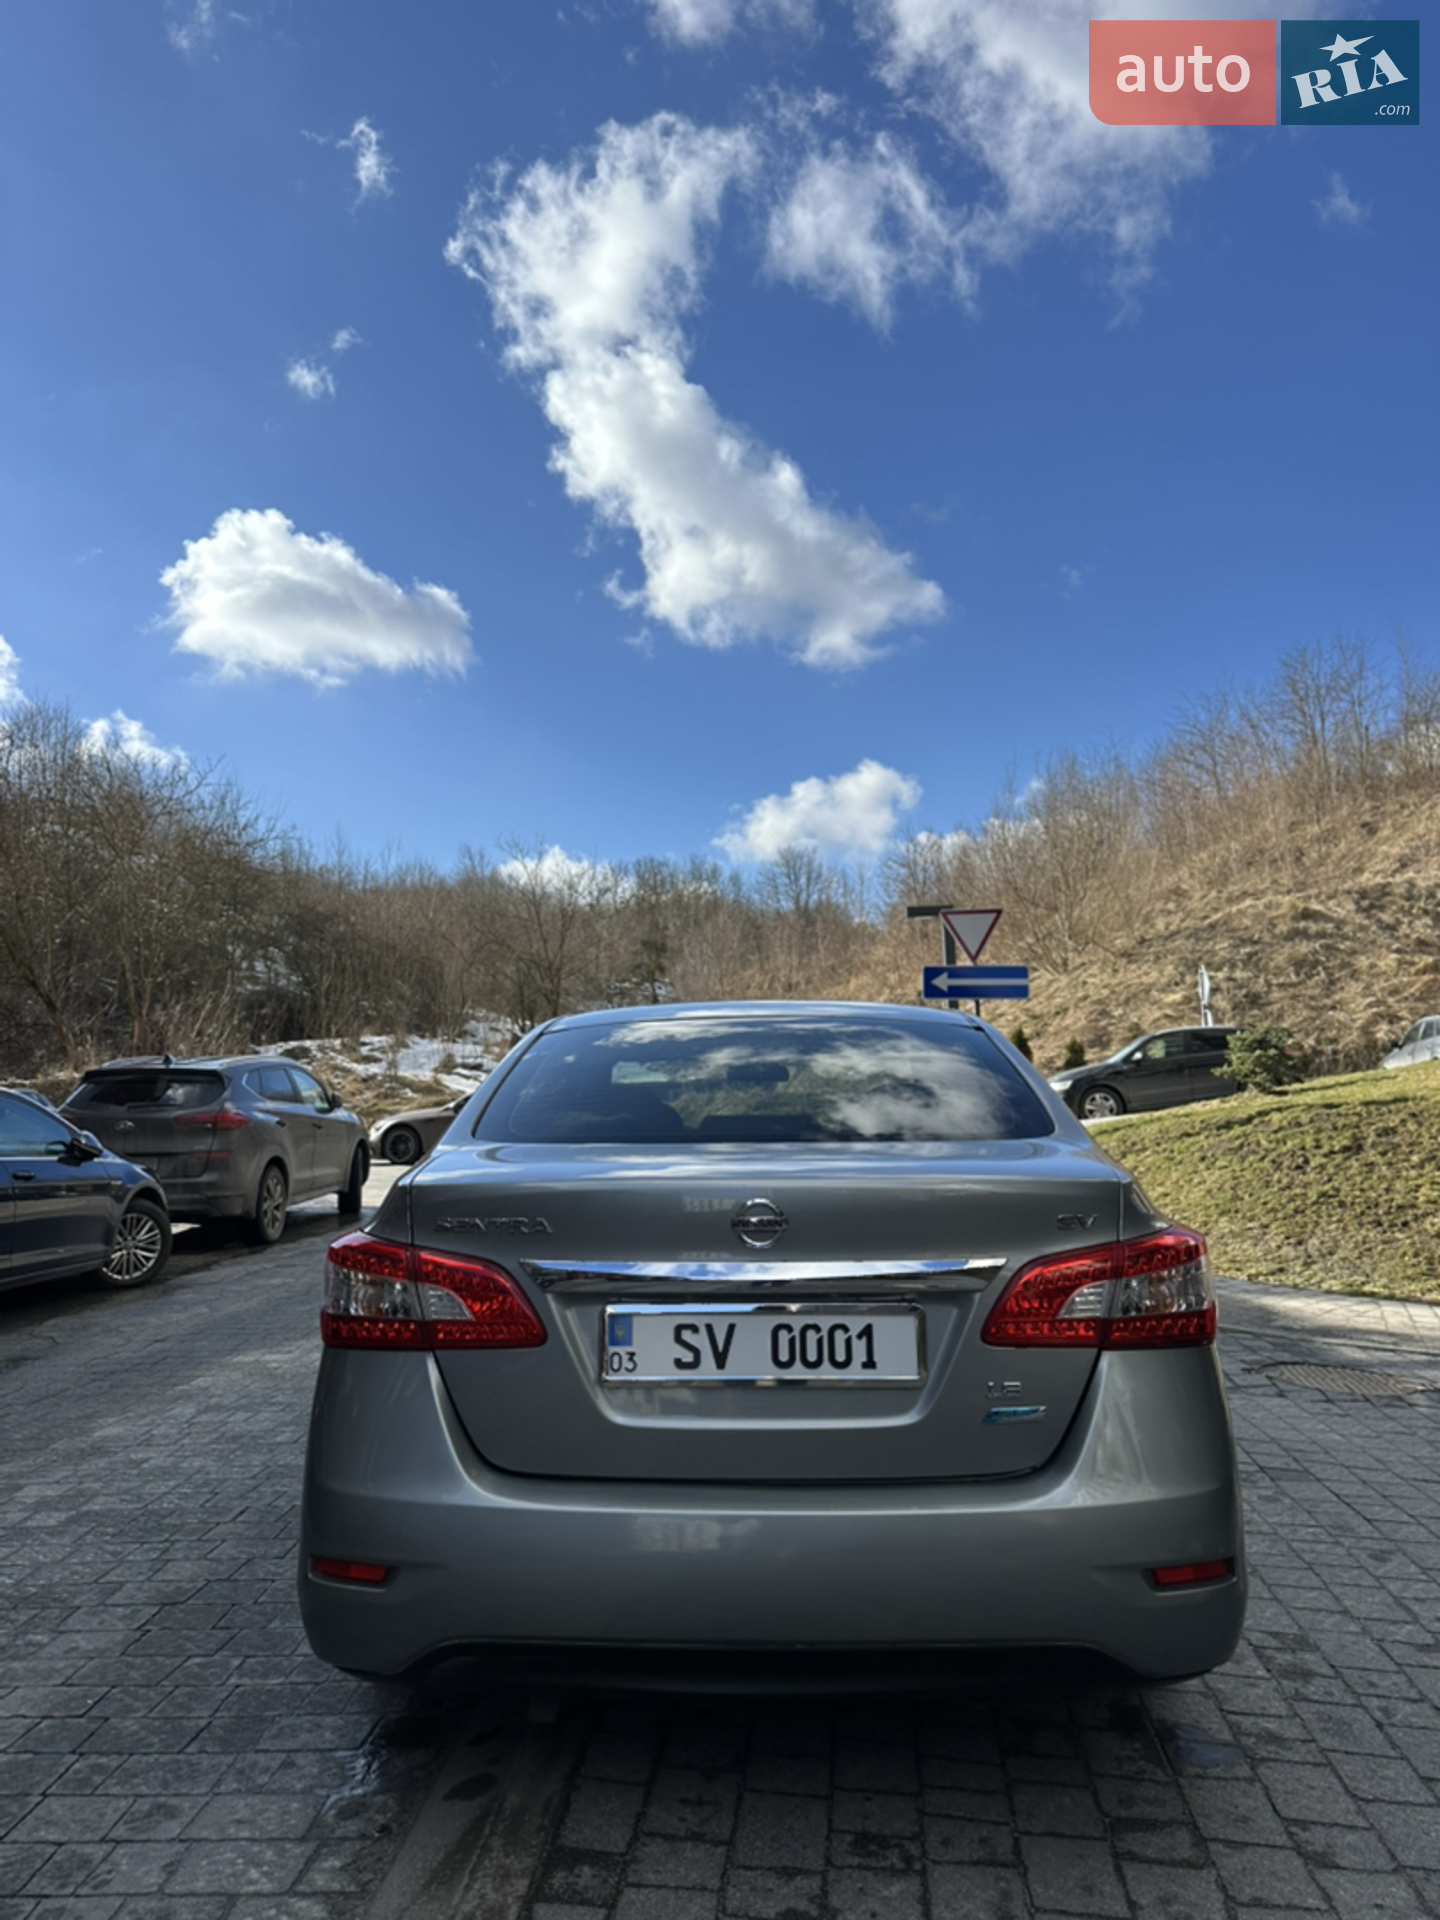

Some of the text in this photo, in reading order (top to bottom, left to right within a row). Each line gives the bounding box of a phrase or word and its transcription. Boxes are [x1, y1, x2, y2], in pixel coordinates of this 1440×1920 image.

[608, 1351, 638, 1373] 03
[673, 1323, 877, 1370] SV 0001
